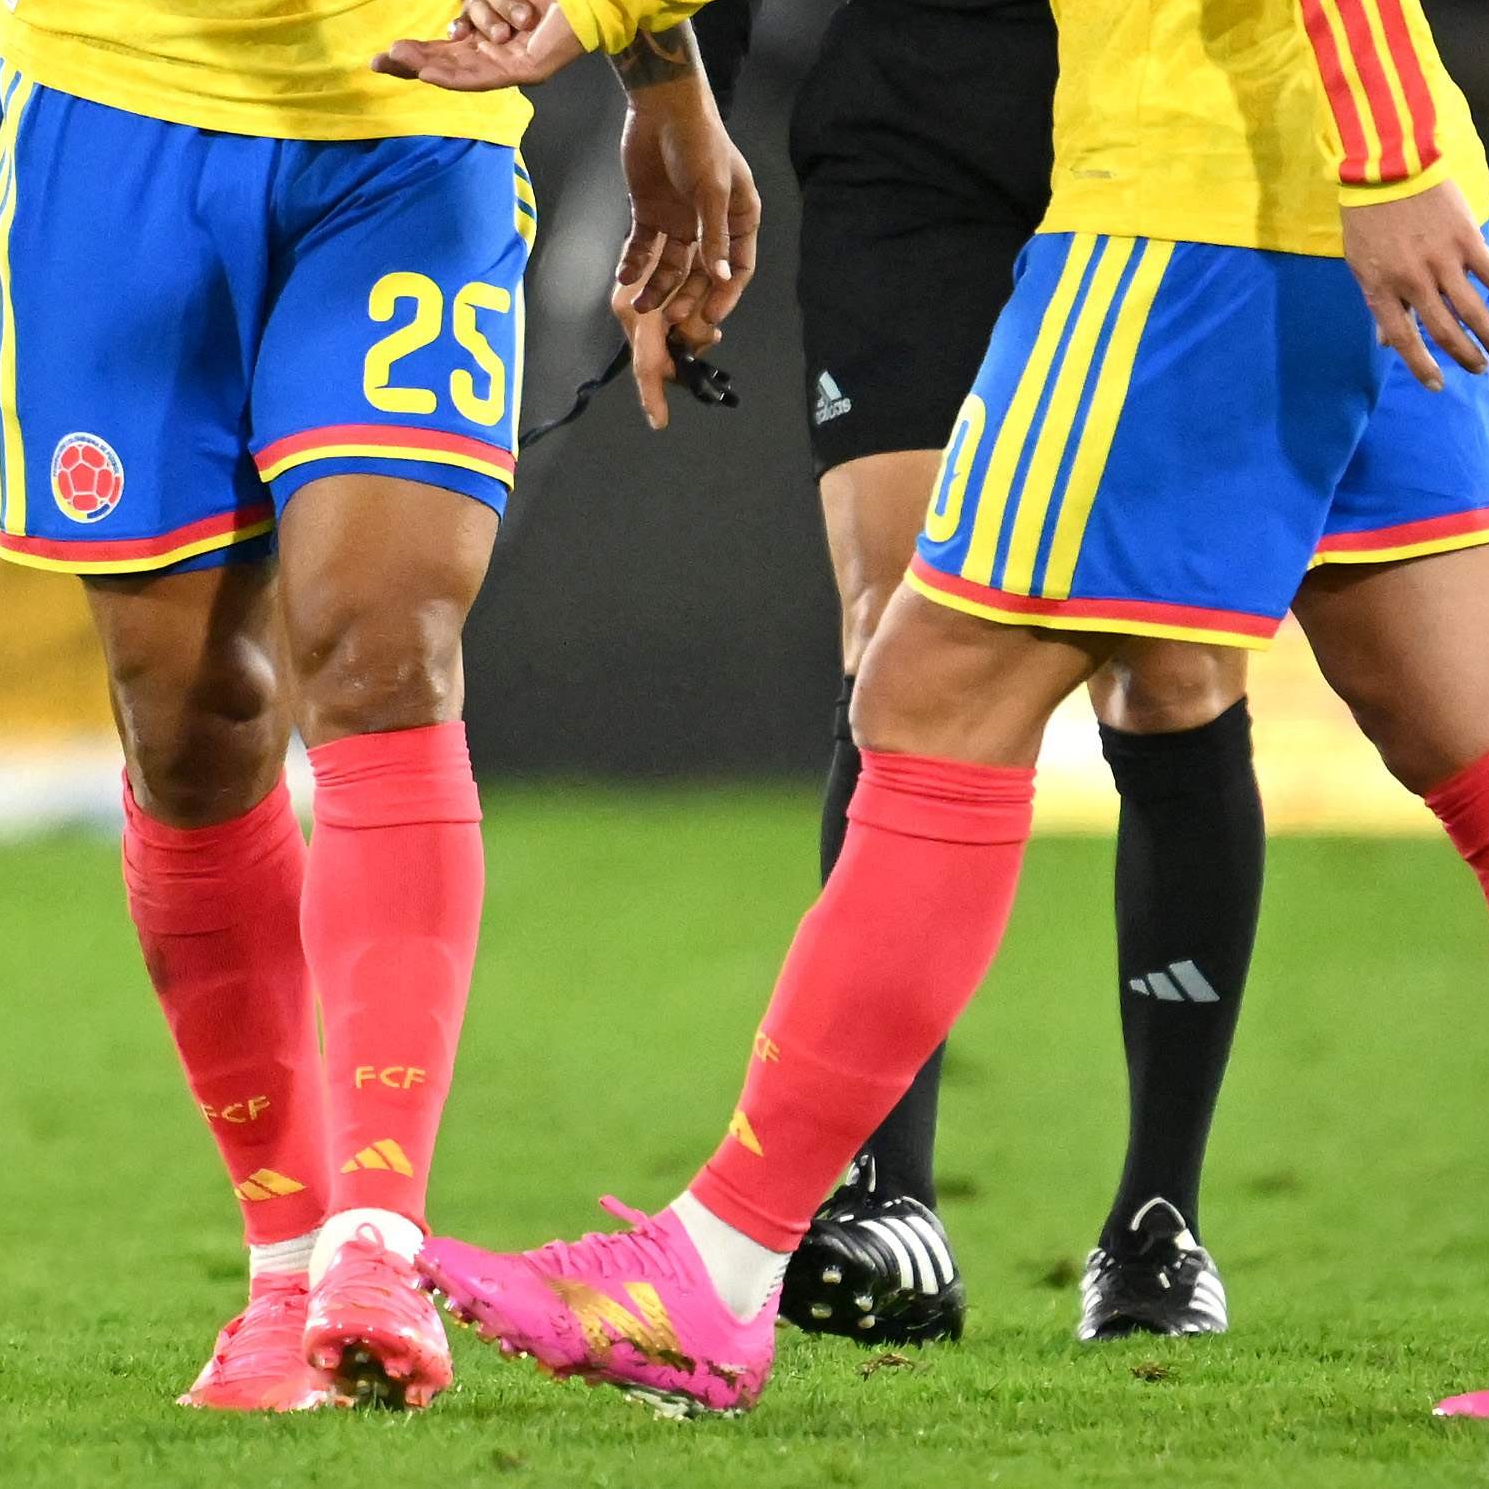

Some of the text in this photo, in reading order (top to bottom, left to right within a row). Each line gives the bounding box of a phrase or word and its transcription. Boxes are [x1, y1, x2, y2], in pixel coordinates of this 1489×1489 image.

[363, 271, 511, 427] 25
[355, 1065, 426, 1089] FCF
[200, 1095, 271, 1124] FCF
